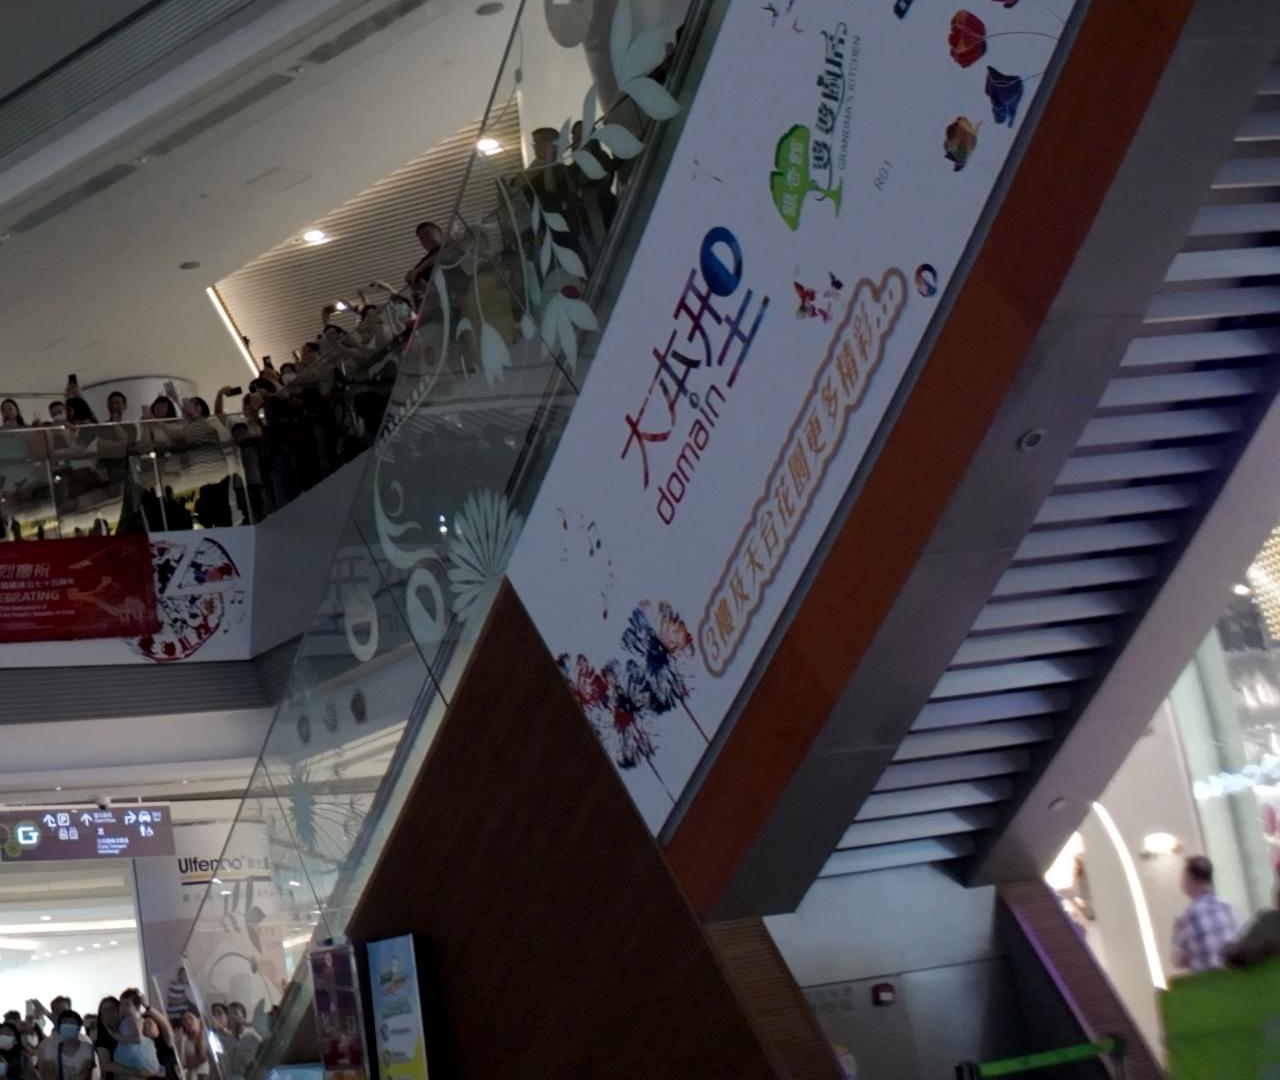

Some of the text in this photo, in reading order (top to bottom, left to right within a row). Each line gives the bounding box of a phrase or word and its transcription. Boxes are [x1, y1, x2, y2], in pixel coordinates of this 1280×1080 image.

[847, 35, 861, 91] KITCHEN
[656, 384, 726, 525] domain
[17, 826, 39, 845] G
